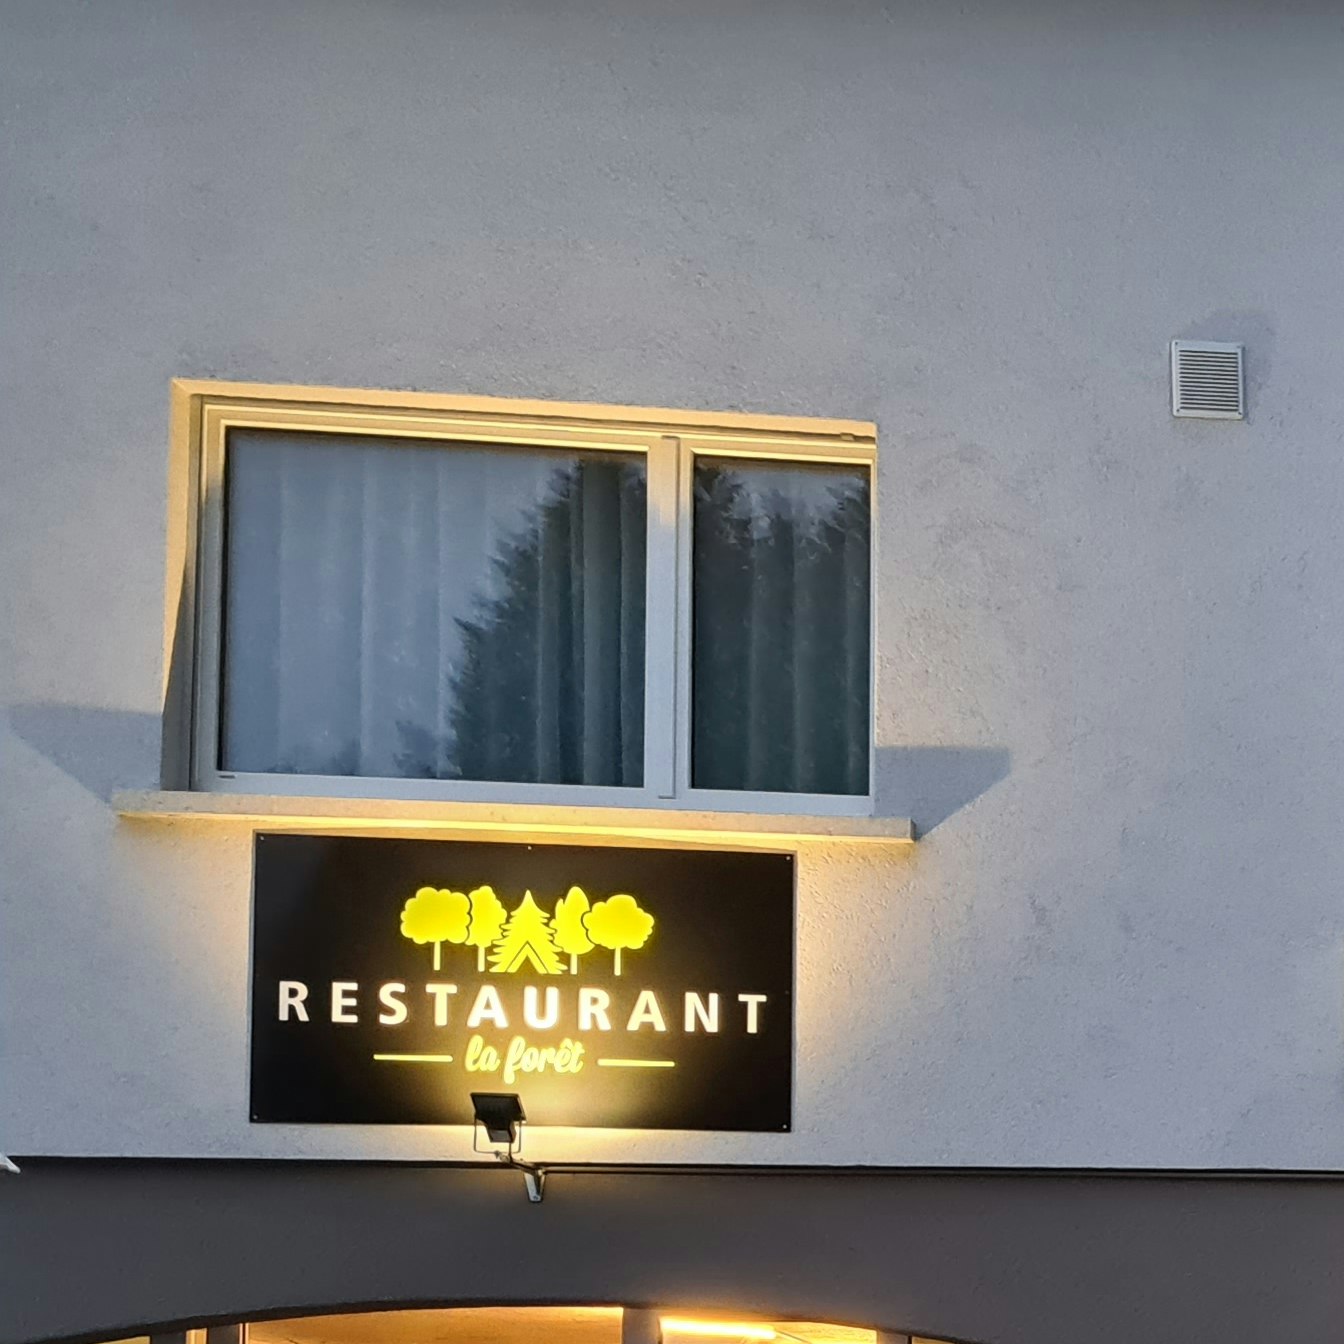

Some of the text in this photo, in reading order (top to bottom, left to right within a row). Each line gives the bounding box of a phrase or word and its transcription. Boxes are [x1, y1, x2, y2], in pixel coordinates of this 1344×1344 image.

[278, 980, 768, 1035] RESTAURANT
[465, 1035, 586, 1084] la forêt
